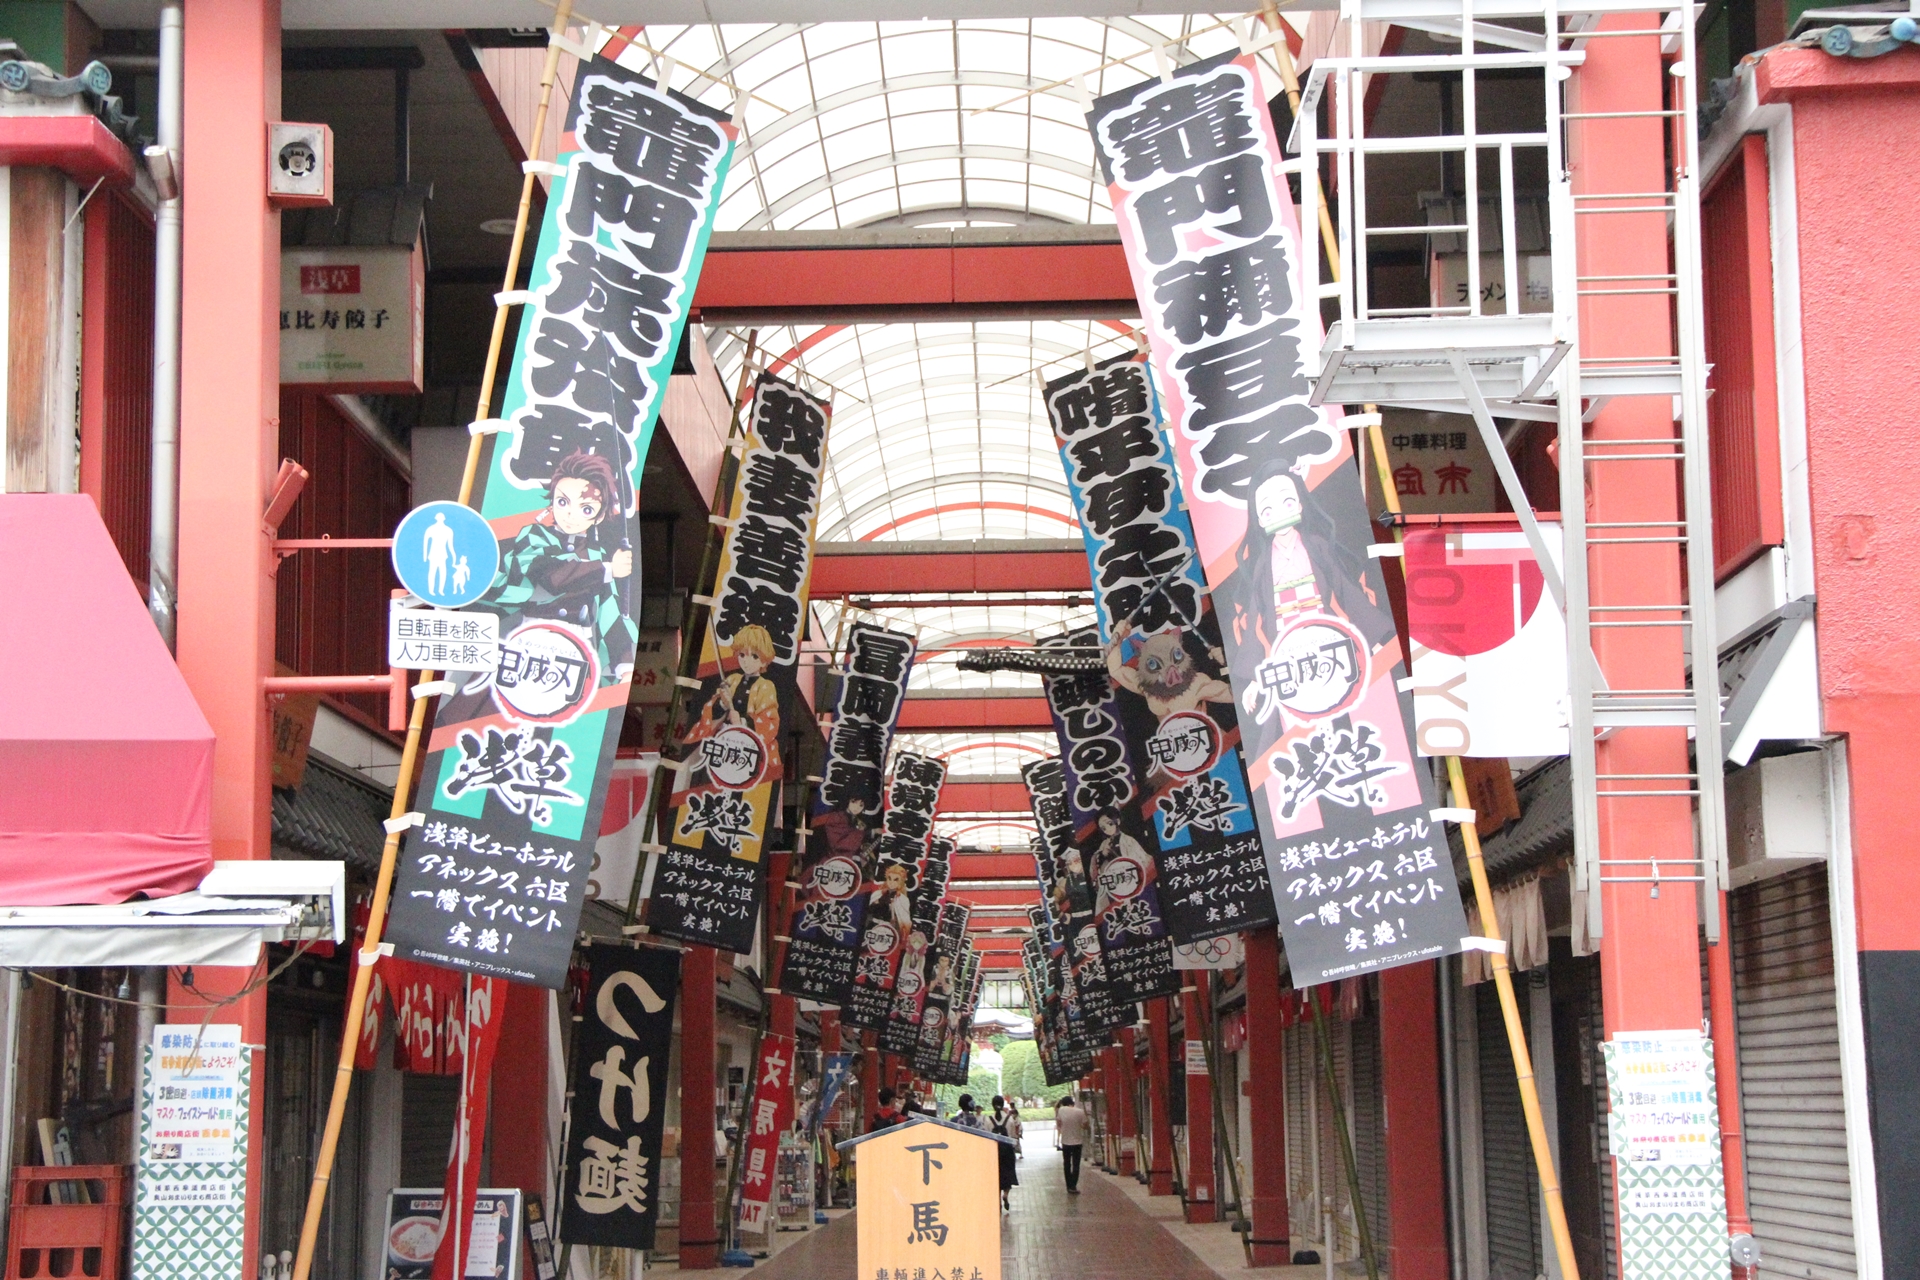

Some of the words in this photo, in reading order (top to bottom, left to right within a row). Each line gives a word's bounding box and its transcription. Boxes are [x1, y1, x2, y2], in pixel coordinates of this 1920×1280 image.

[309, 269, 350, 290] 浅草
[1392, 432, 1467, 451] 中華料理
[397, 617, 493, 641] 自転車を除く
[396, 642, 493, 665] 人力車を除く
[478, 642, 590, 703] 鬼滅の刃
[1257, 638, 1359, 724] 鬼滅の刃
[692, 738, 759, 777] 鬼滅の刃
[1147, 725, 1212, 776] 鬼滅の刃
[445, 729, 585, 824] 浅草
[1274, 726, 1400, 818] 浅草
[681, 793, 760, 852] 浅草
[1159, 781, 1241, 840] 浅草
[423, 820, 575, 873] 浅草ビューホテル
[1163, 837, 1260, 872] 浅草ビューホテル
[1279, 817, 1429, 872] 浅草ビューホテル
[416, 853, 530, 892] アネックス
[525, 875, 569, 904] 六区
[666, 850, 757, 883] 浅草ビューホテル
[807, 866, 856, 889] 鬼滅の刃
[1097, 867, 1139, 896] 鬼滅の刃
[1168, 865, 1234, 890] アネックス
[1236, 856, 1266, 877] 六区
[1286, 862, 1389, 901] アネックス
[1392, 846, 1438, 876] 六区
[662, 870, 725, 894] アネックス
[727, 884, 753, 902] 六区
[1172, 878, 1270, 909] 一階でイベント
[1293, 878, 1444, 927] 一階でイベント
[410, 888, 563, 933] 一階でイベント
[659, 891, 750, 921] 一階でイベント
[801, 901, 856, 941] 浅草
[1103, 900, 1161, 940] 浅草
[789, 952, 832, 968] アネックス
[833, 960, 851, 973] 六区
[791, 939, 854, 961] 浅草ビューホテル
[1107, 939, 1169, 961] 浅草ビューホテル
[1109, 957, 1152, 972] アネックス
[1153, 951, 1171, 964] 六区
[154, 1184, 227, 1193] 浅草西参道商店街
[903, 1141, 950, 1247] 下馬
